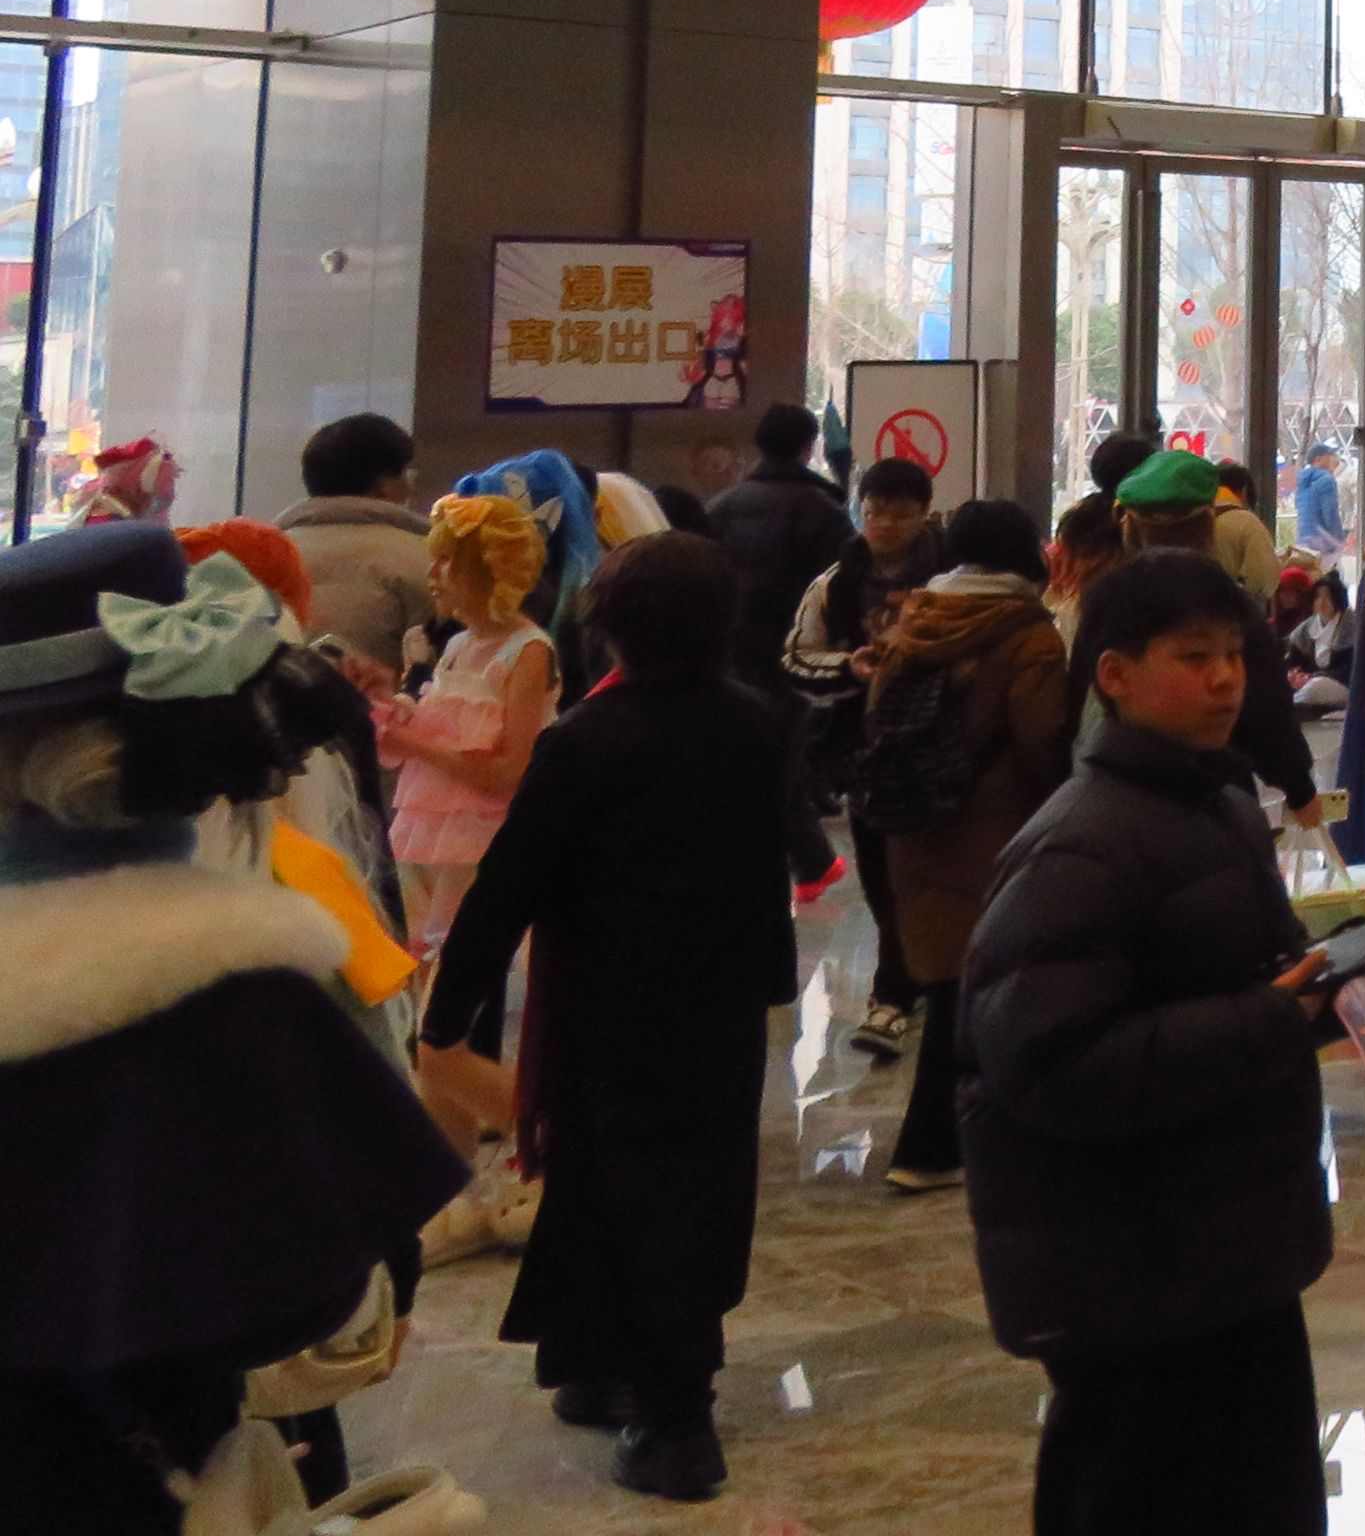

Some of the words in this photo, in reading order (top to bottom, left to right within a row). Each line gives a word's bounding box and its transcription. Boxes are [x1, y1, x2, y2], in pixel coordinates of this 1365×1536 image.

[559, 265, 654, 312] 漫展
[507, 319, 698, 367] 离场出口
